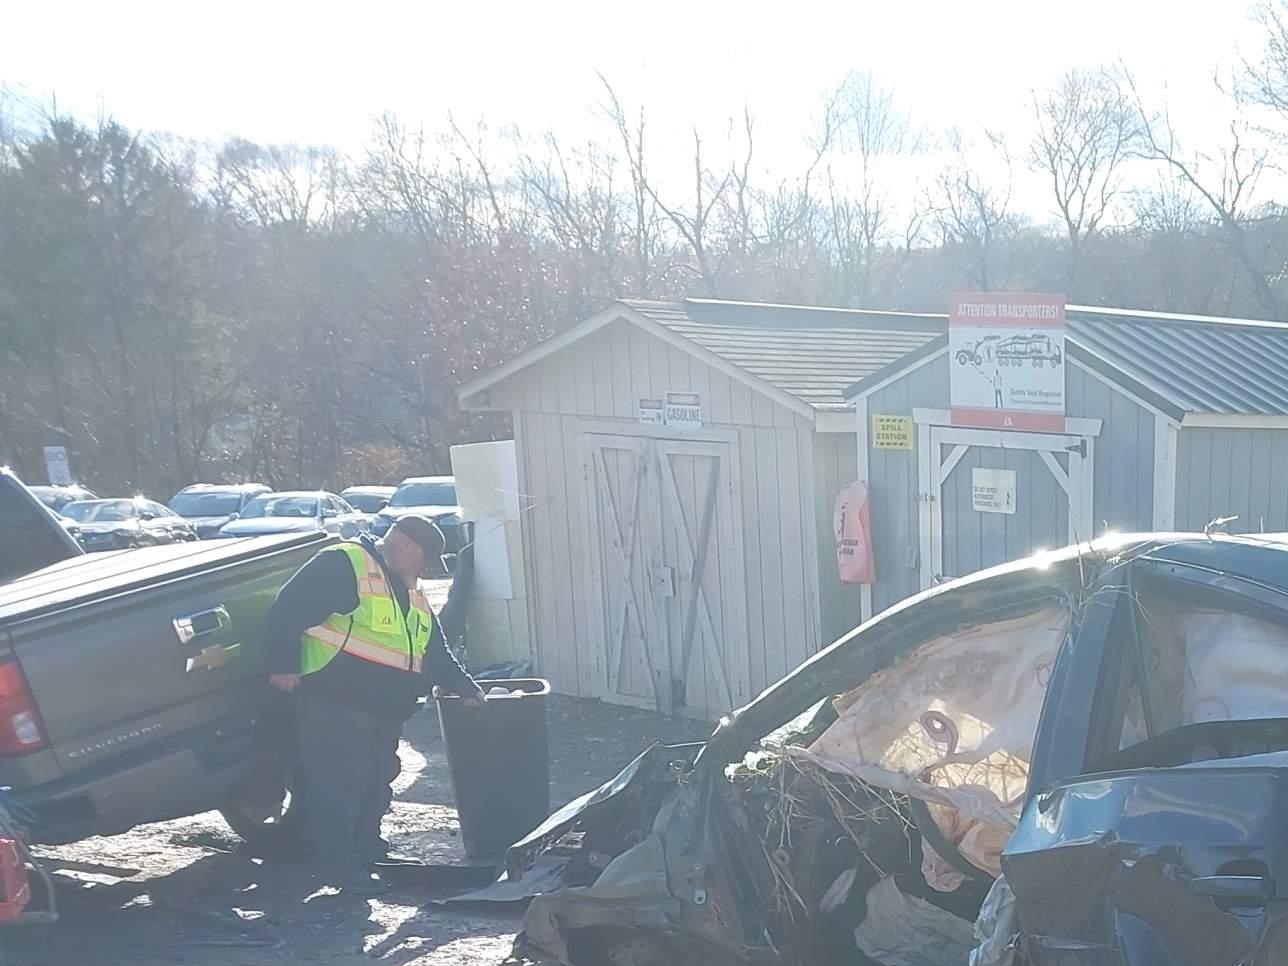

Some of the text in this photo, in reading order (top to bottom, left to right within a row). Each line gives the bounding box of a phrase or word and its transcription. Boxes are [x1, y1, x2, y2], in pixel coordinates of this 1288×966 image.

[958, 303, 1059, 319] ATTENTION TRANSPORTERS!
[667, 407, 700, 422] GASOLINE
[876, 433, 907, 441] STATION
